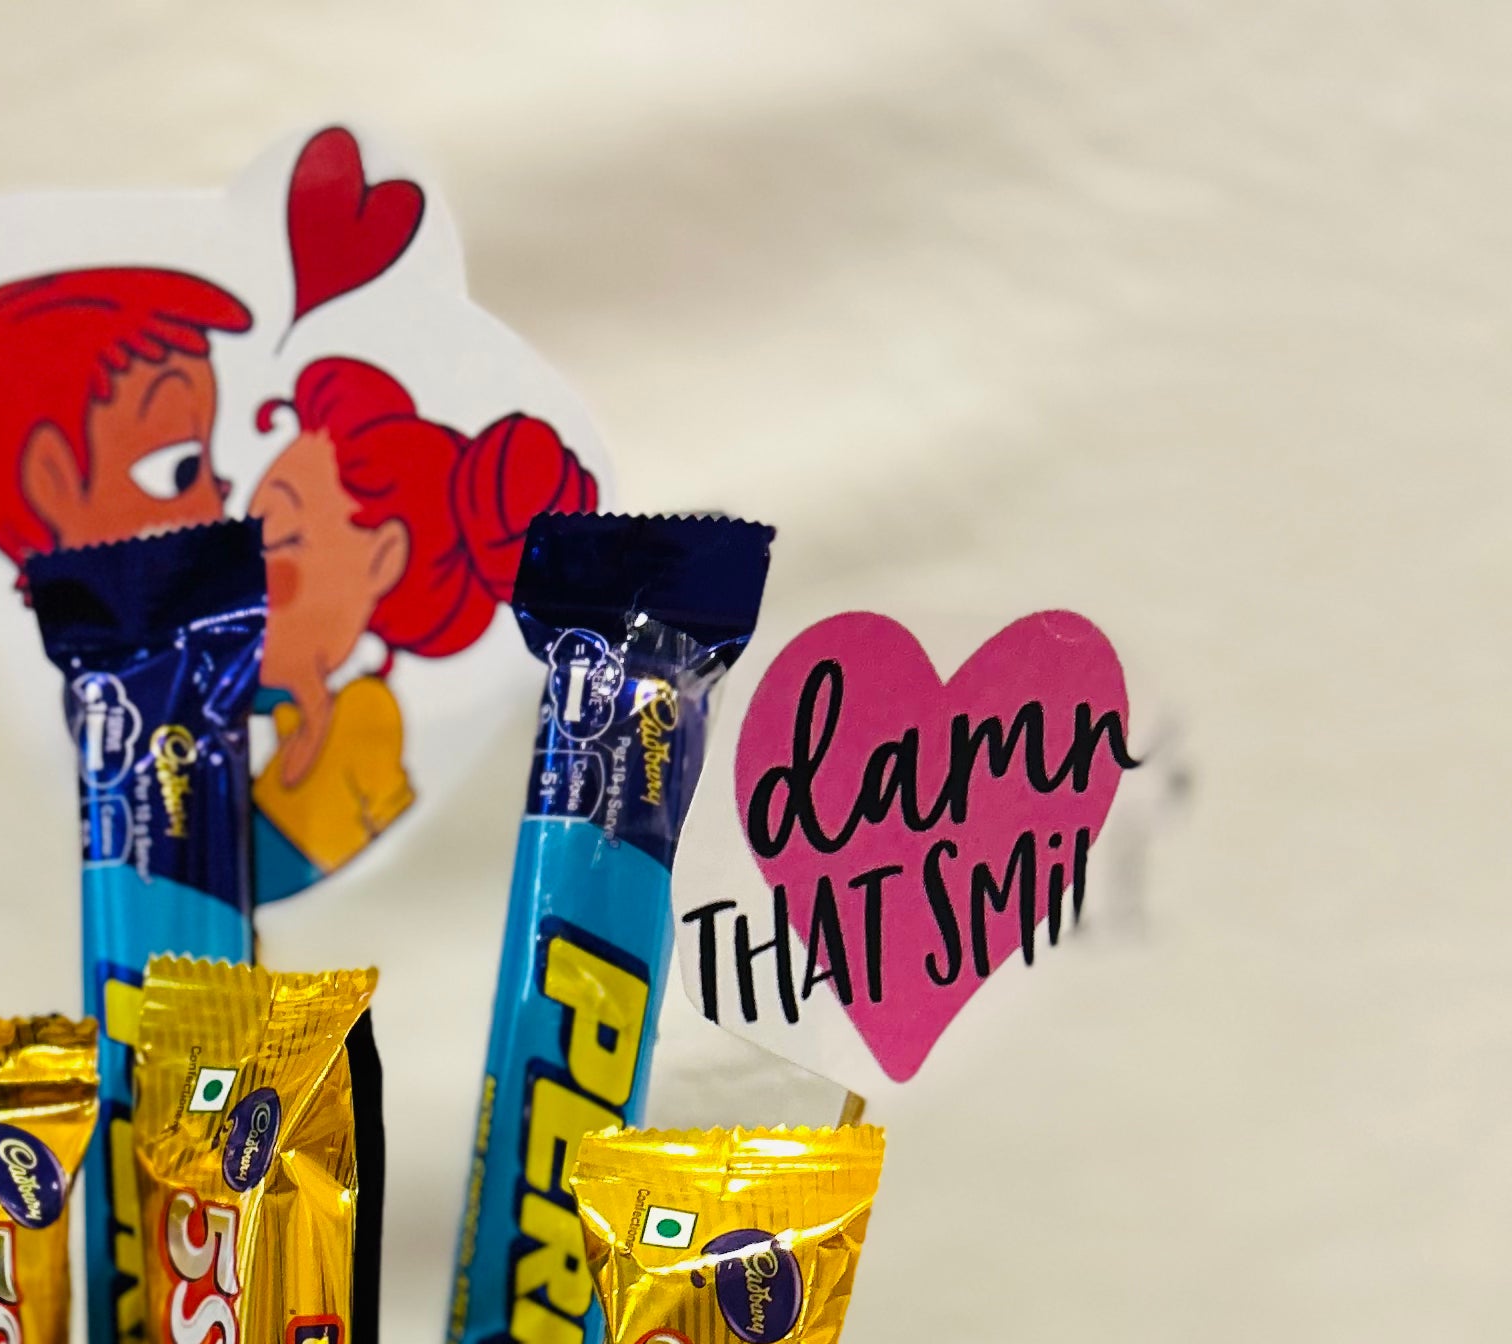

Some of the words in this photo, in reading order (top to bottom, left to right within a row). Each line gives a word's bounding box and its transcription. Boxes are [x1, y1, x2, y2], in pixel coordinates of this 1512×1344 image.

[746, 658, 1143, 859] damn
[681, 864, 904, 1025] THAT
[236, 1102, 271, 1182] Cadbury
[739, 1248, 780, 1335] Cadbury
